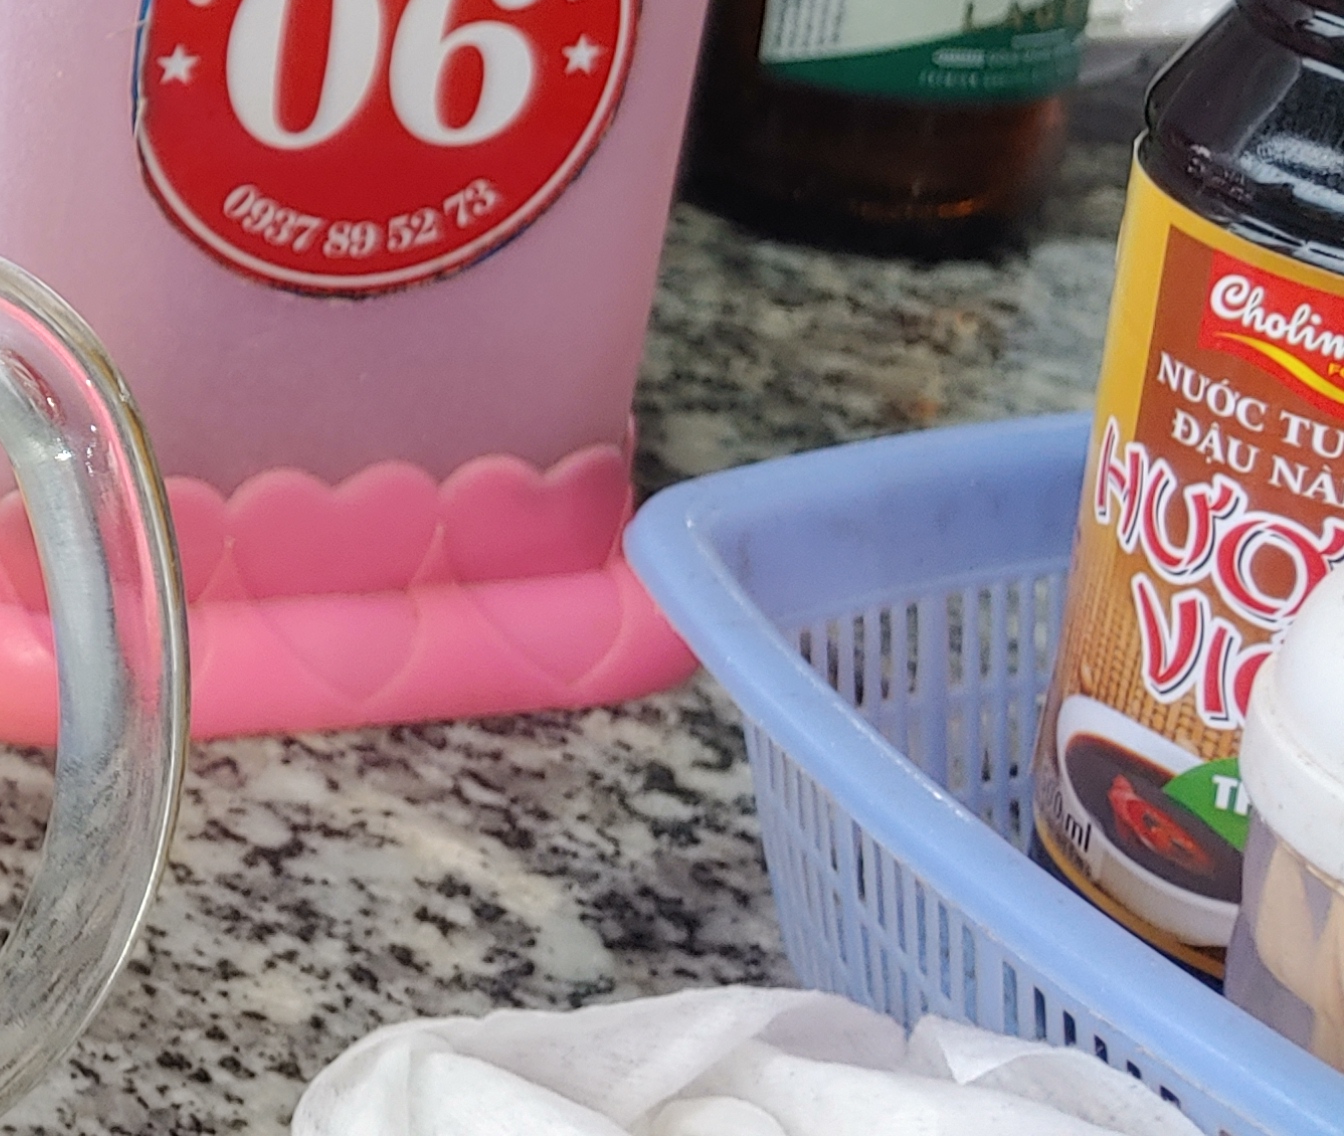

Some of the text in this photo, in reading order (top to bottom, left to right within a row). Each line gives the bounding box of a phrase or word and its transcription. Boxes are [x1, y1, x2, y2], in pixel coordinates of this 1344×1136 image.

[223, 178, 499, 259] 0937 89 52 73
[1157, 351, 1268, 432] NƯỚC
[1171, 408, 1344, 509] ĐẬU NÀ
